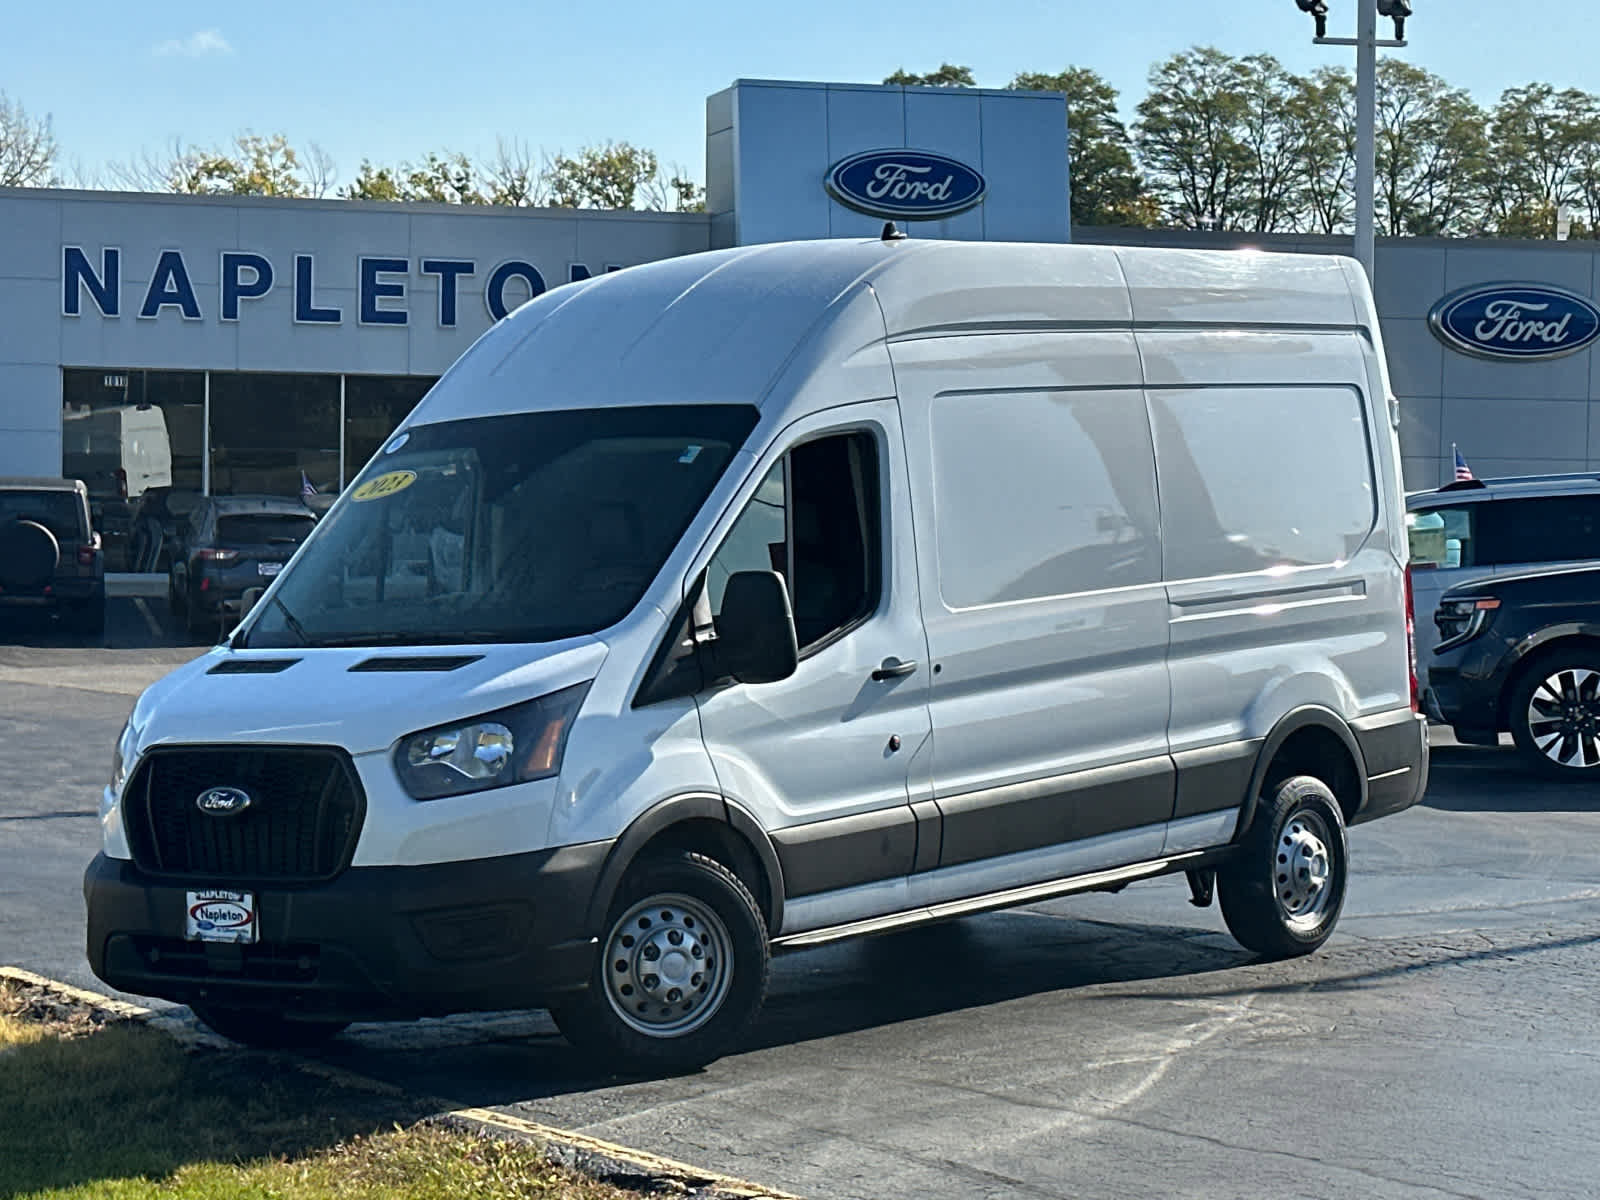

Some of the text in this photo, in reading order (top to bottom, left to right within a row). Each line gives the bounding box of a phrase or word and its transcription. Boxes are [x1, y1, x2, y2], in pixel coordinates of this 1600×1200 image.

[866, 163, 953, 200] Ford
[1474, 299, 1572, 343] Ford
[204, 791, 235, 808] Ford
[200, 906, 244, 922] Napleton
